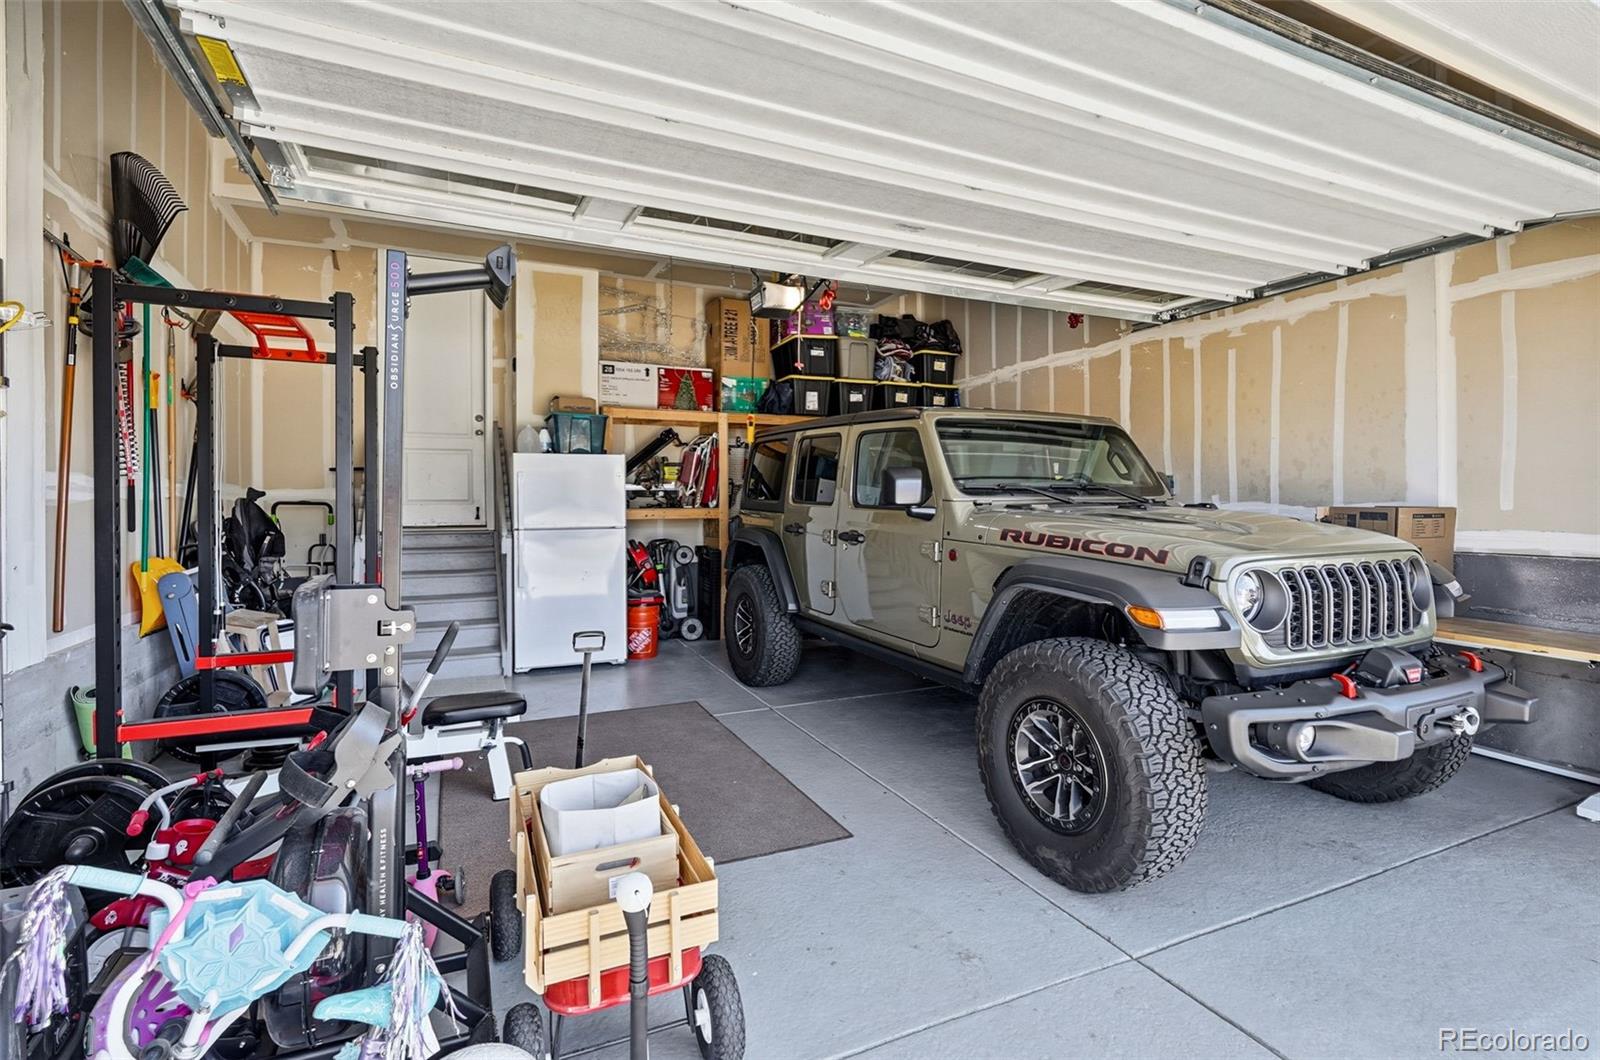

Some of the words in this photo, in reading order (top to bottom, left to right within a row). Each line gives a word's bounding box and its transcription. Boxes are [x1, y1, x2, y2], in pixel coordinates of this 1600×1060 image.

[390, 261, 400, 289] 500
[1000, 528, 1169, 565] RUBICON
[943, 609, 972, 630] Jeep
[379, 828, 387, 864] FITNESS
[379, 872, 387, 905] HEALTH
